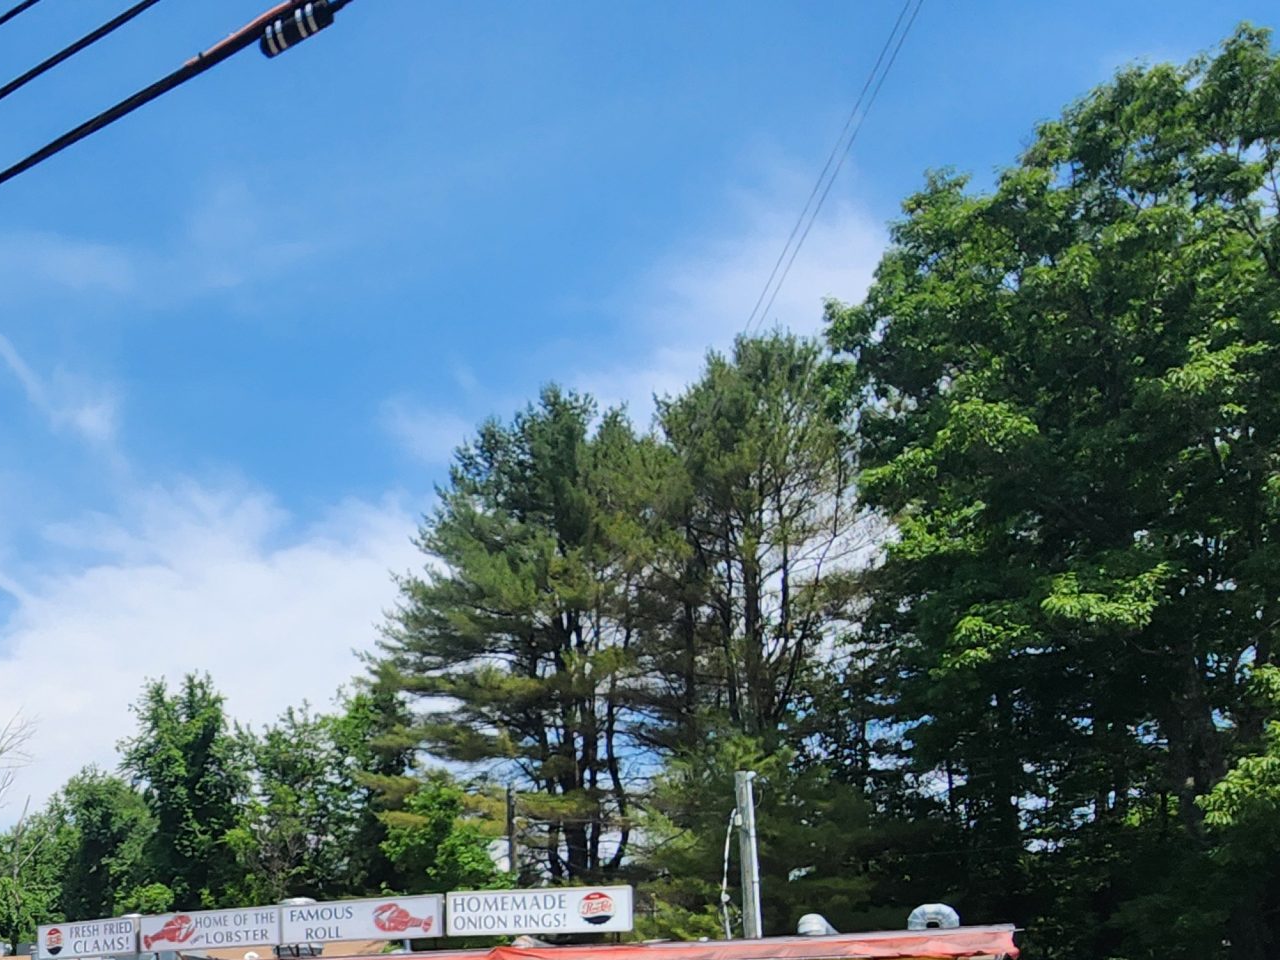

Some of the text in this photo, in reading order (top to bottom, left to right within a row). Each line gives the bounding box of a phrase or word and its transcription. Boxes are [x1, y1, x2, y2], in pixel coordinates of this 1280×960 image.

[453, 894, 567, 913] HOMEMADE
[195, 911, 275, 929] HOME OF THE
[290, 906, 353, 922] FAMOUS
[453, 913, 567, 930] ONION RINGS!
[69, 920, 132, 939] FRESH FRIED
[205, 929, 269, 944] LOBSTER
[305, 926, 343, 940] ROLL
[73, 936, 129, 954] CLAMS!
